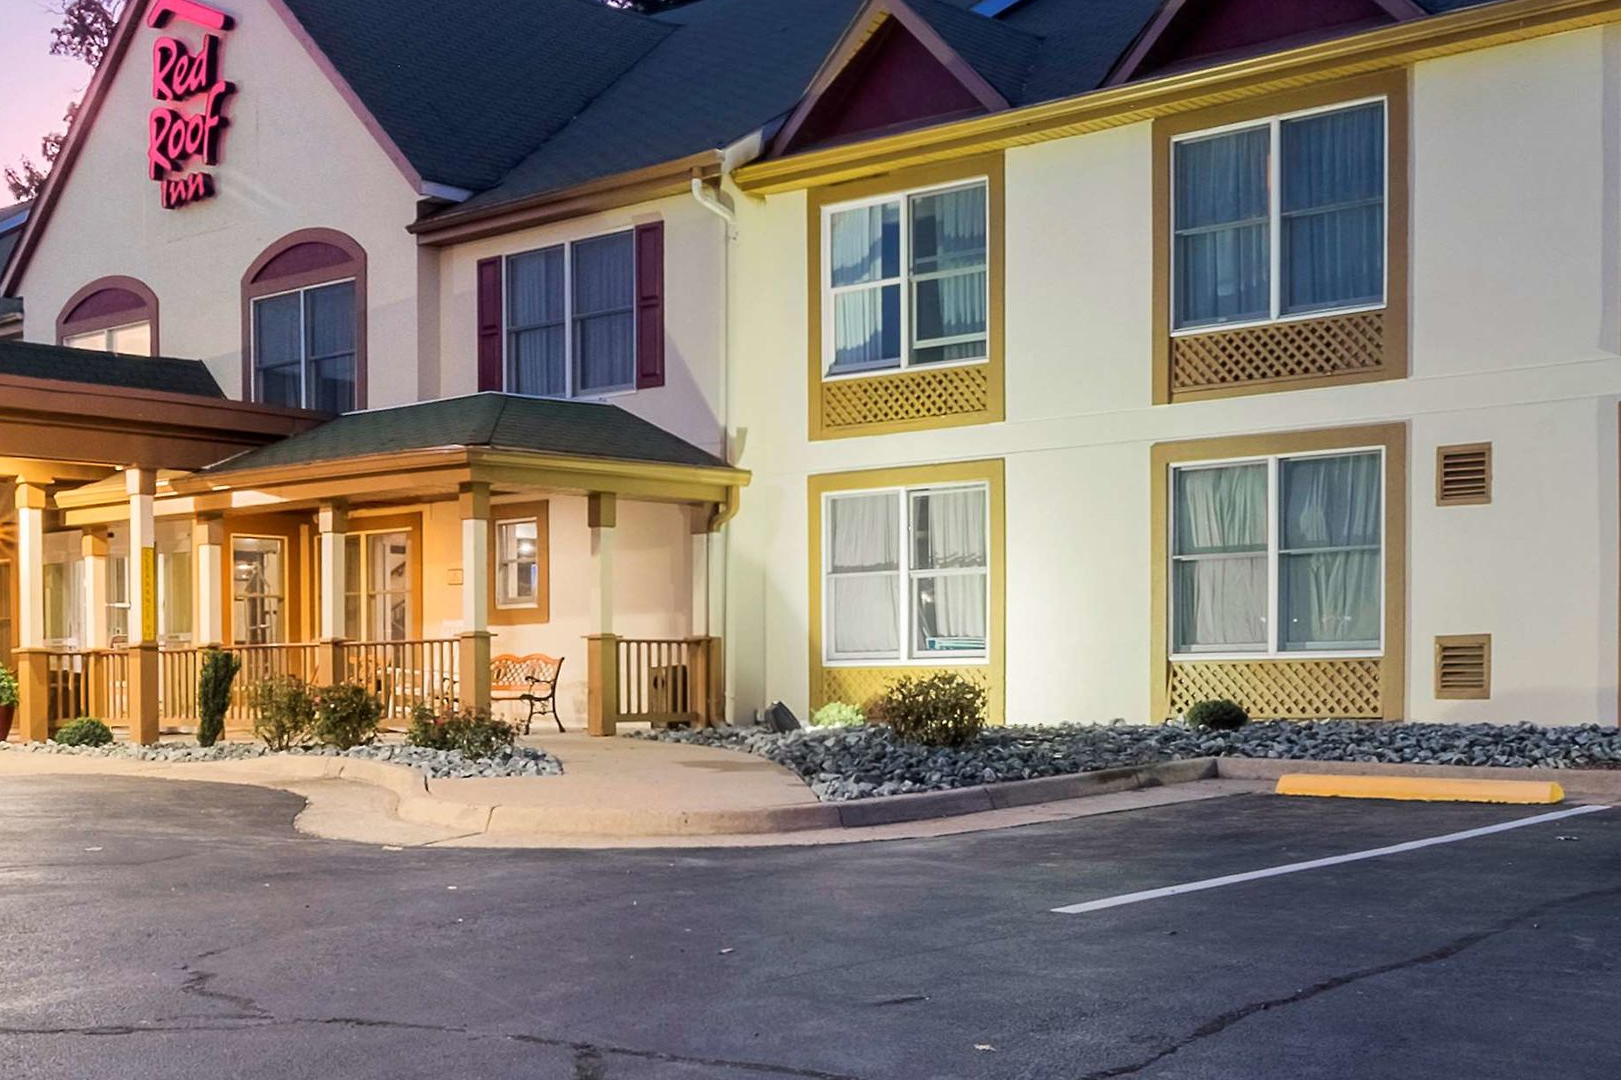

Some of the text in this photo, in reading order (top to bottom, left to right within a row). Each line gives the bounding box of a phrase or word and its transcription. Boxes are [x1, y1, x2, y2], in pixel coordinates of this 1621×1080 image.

[152, 34, 218, 101] Red
[149, 81, 228, 180] Roof
[161, 173, 210, 209] Inn
